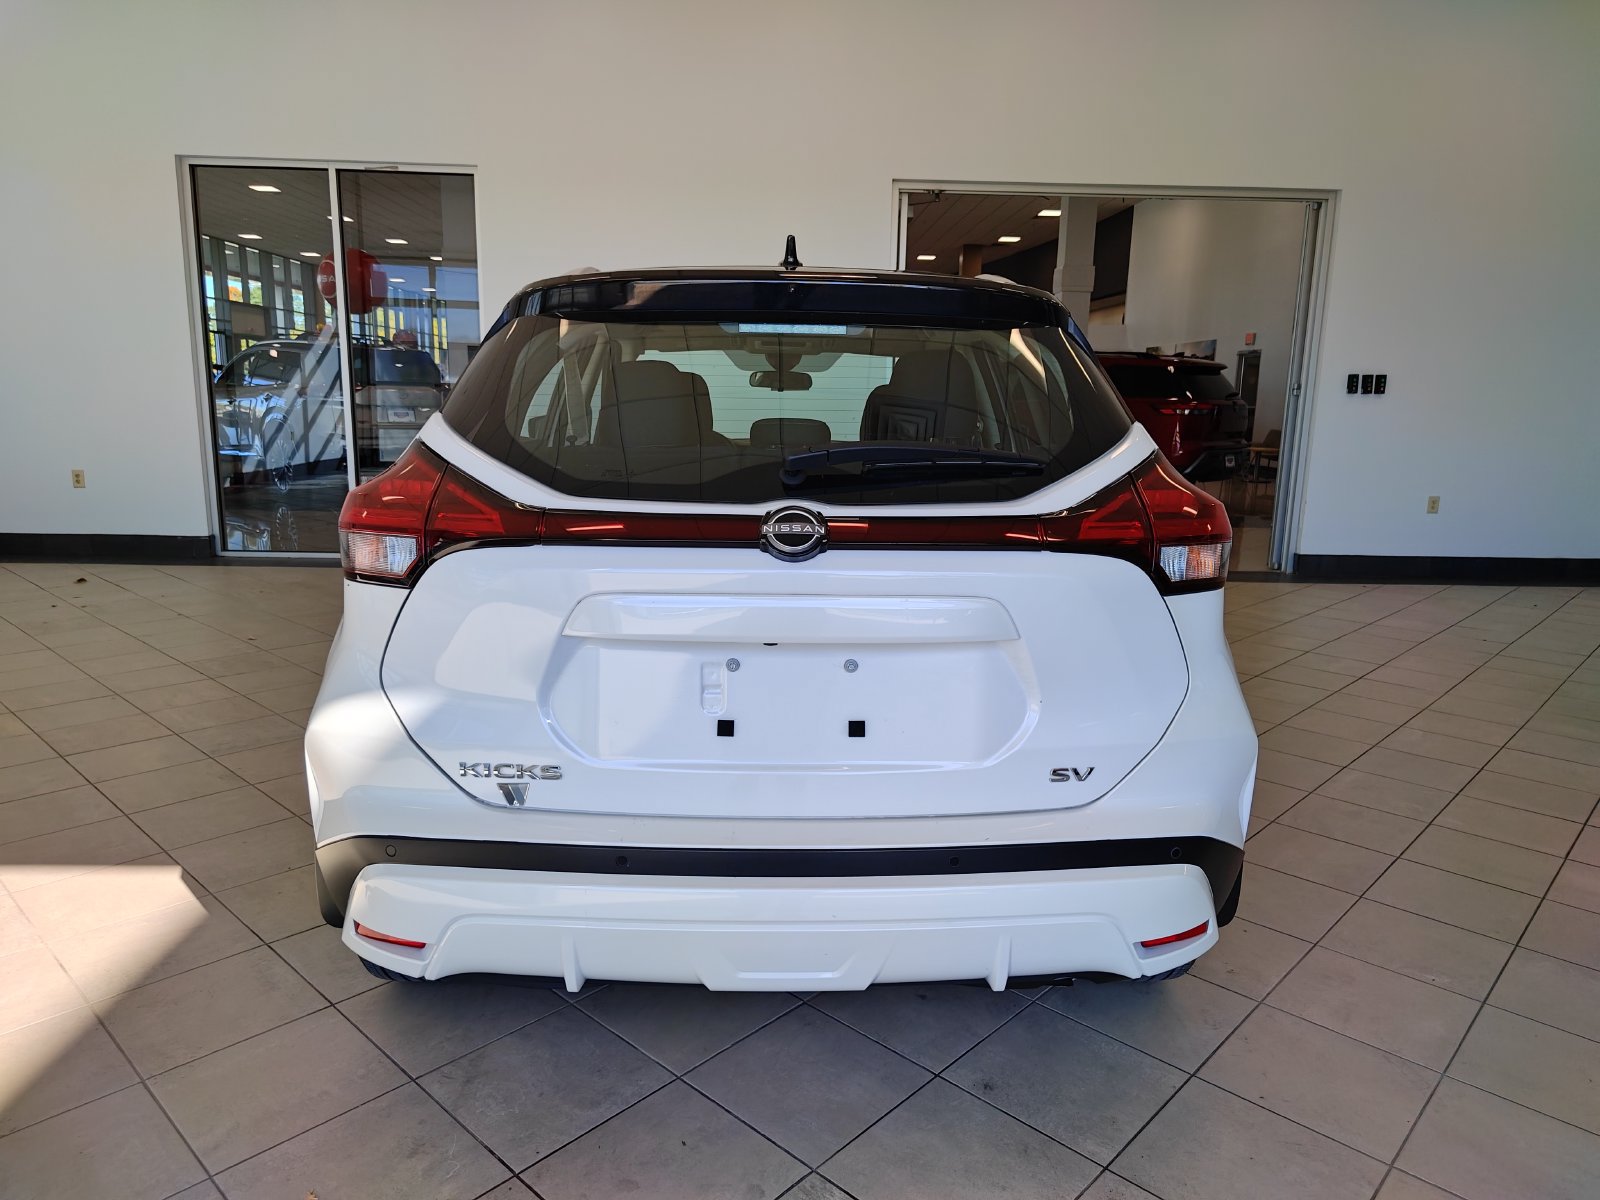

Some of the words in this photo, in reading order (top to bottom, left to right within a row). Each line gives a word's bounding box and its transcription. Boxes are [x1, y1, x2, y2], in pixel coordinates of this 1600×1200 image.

[763, 524, 825, 534] NISSAN
[459, 762, 563, 780] KICKS
[1049, 766, 1095, 782] SV
